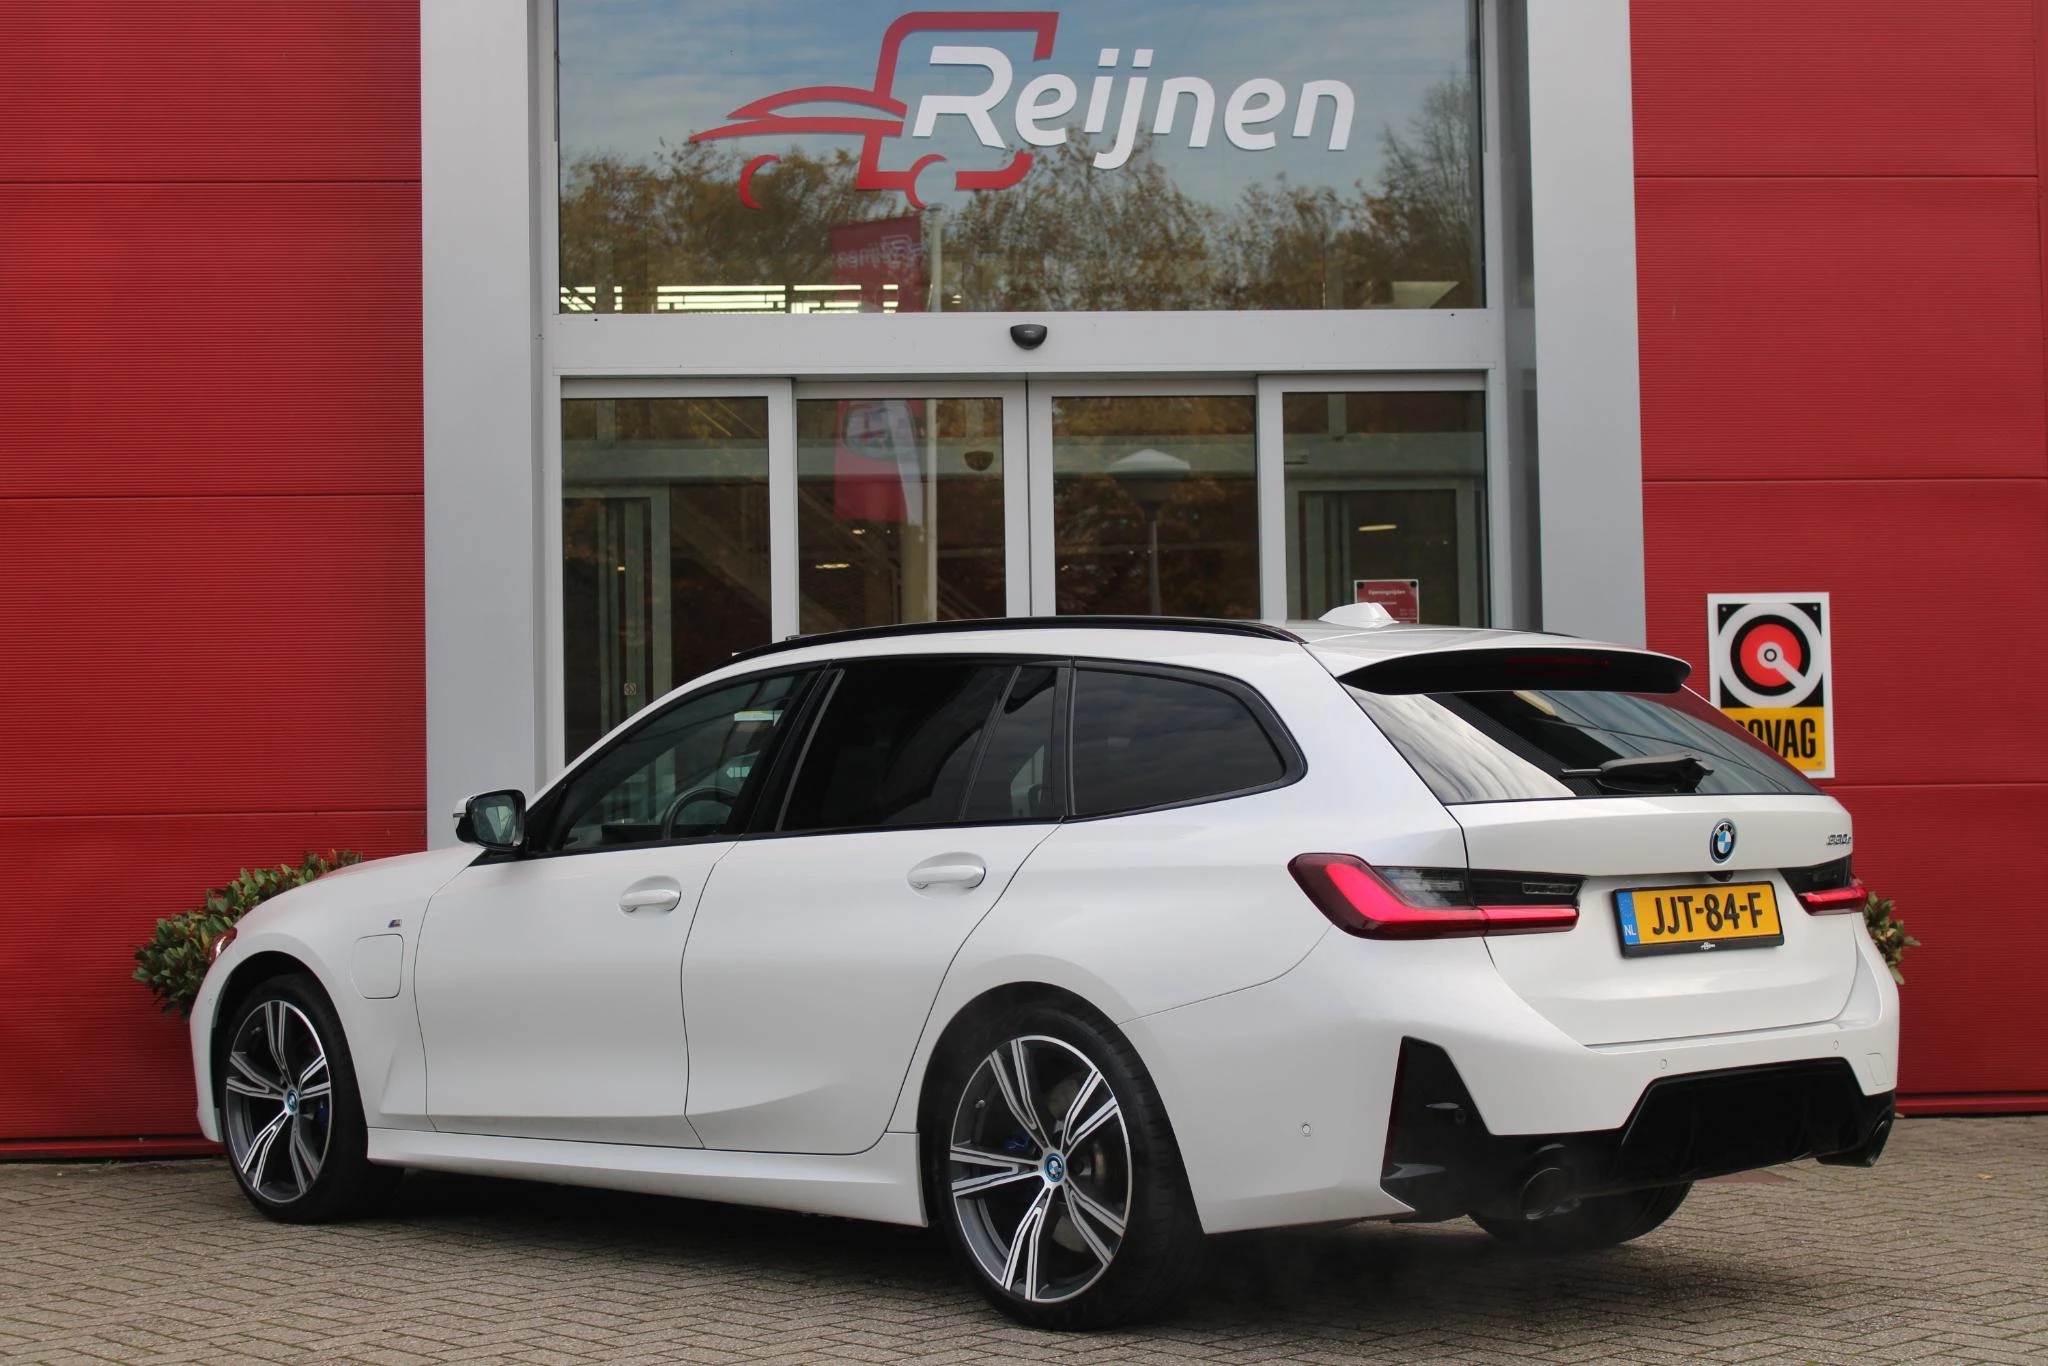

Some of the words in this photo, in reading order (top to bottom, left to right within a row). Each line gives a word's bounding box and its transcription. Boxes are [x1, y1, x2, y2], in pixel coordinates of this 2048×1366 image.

[912, 45, 1355, 169] Reijnen
[1735, 717, 1817, 759] VAG
[1624, 924, 1637, 937] NL
[1652, 892, 1763, 935] JJT-84-F
